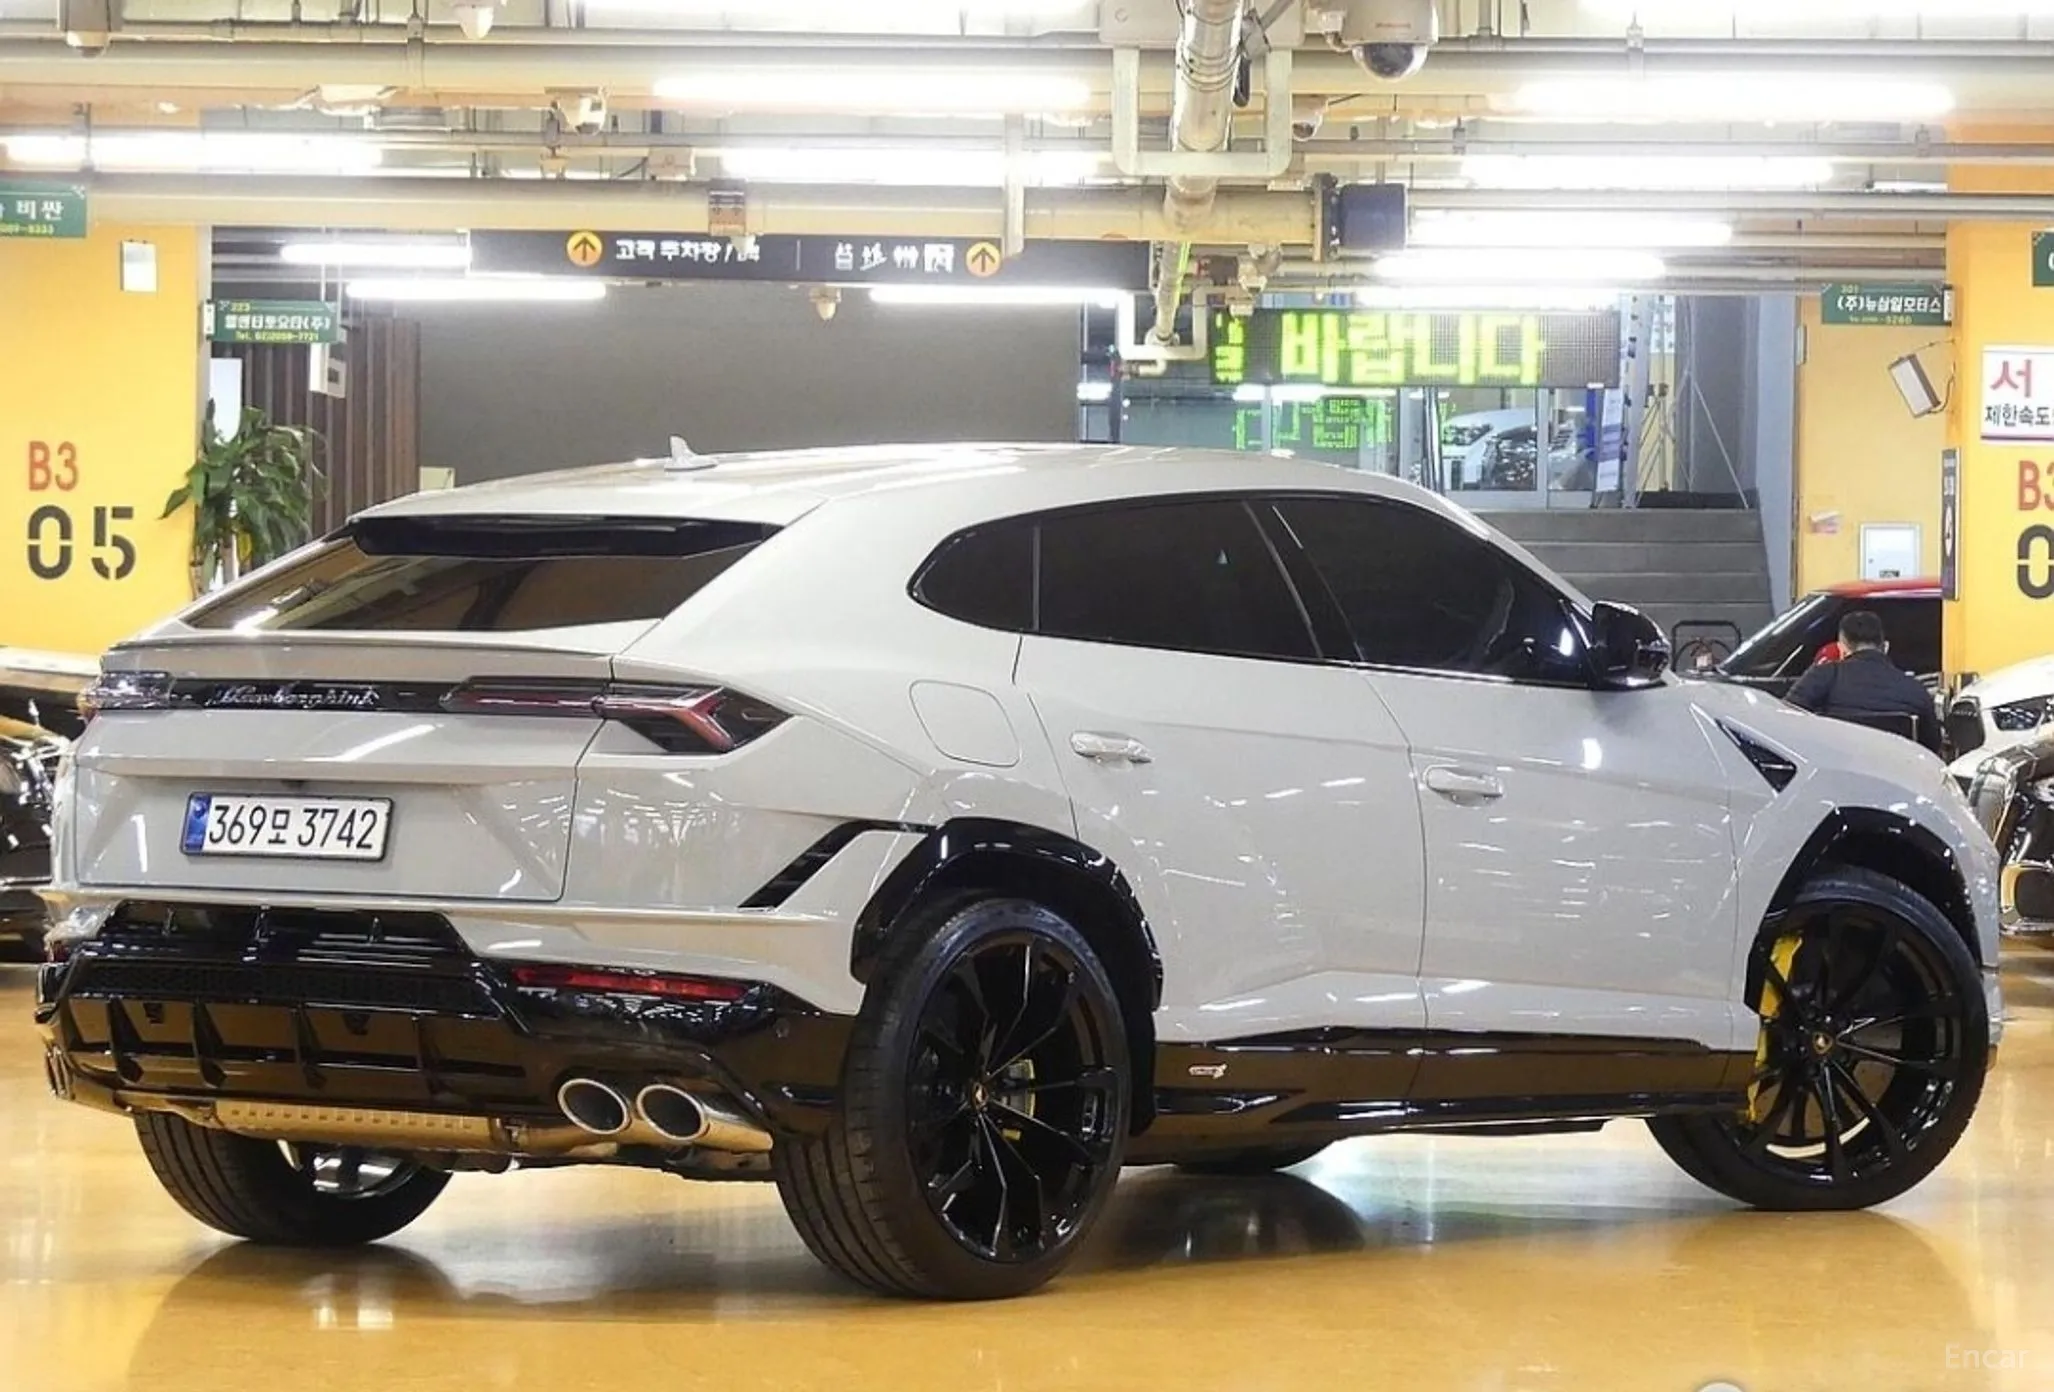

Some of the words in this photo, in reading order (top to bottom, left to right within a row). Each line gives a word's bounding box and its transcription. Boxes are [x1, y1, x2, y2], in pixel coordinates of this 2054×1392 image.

[660, 240, 721, 263] 주차장
[1281, 311, 1546, 384] 바랍니다
[1990, 359, 2032, 398] 서
[1984, 403, 2054, 427] 제한속도
[28, 440, 79, 491] B3
[27, 504, 136, 580] 05
[208, 804, 290, 845] 369모
[297, 807, 378, 849] 3742
